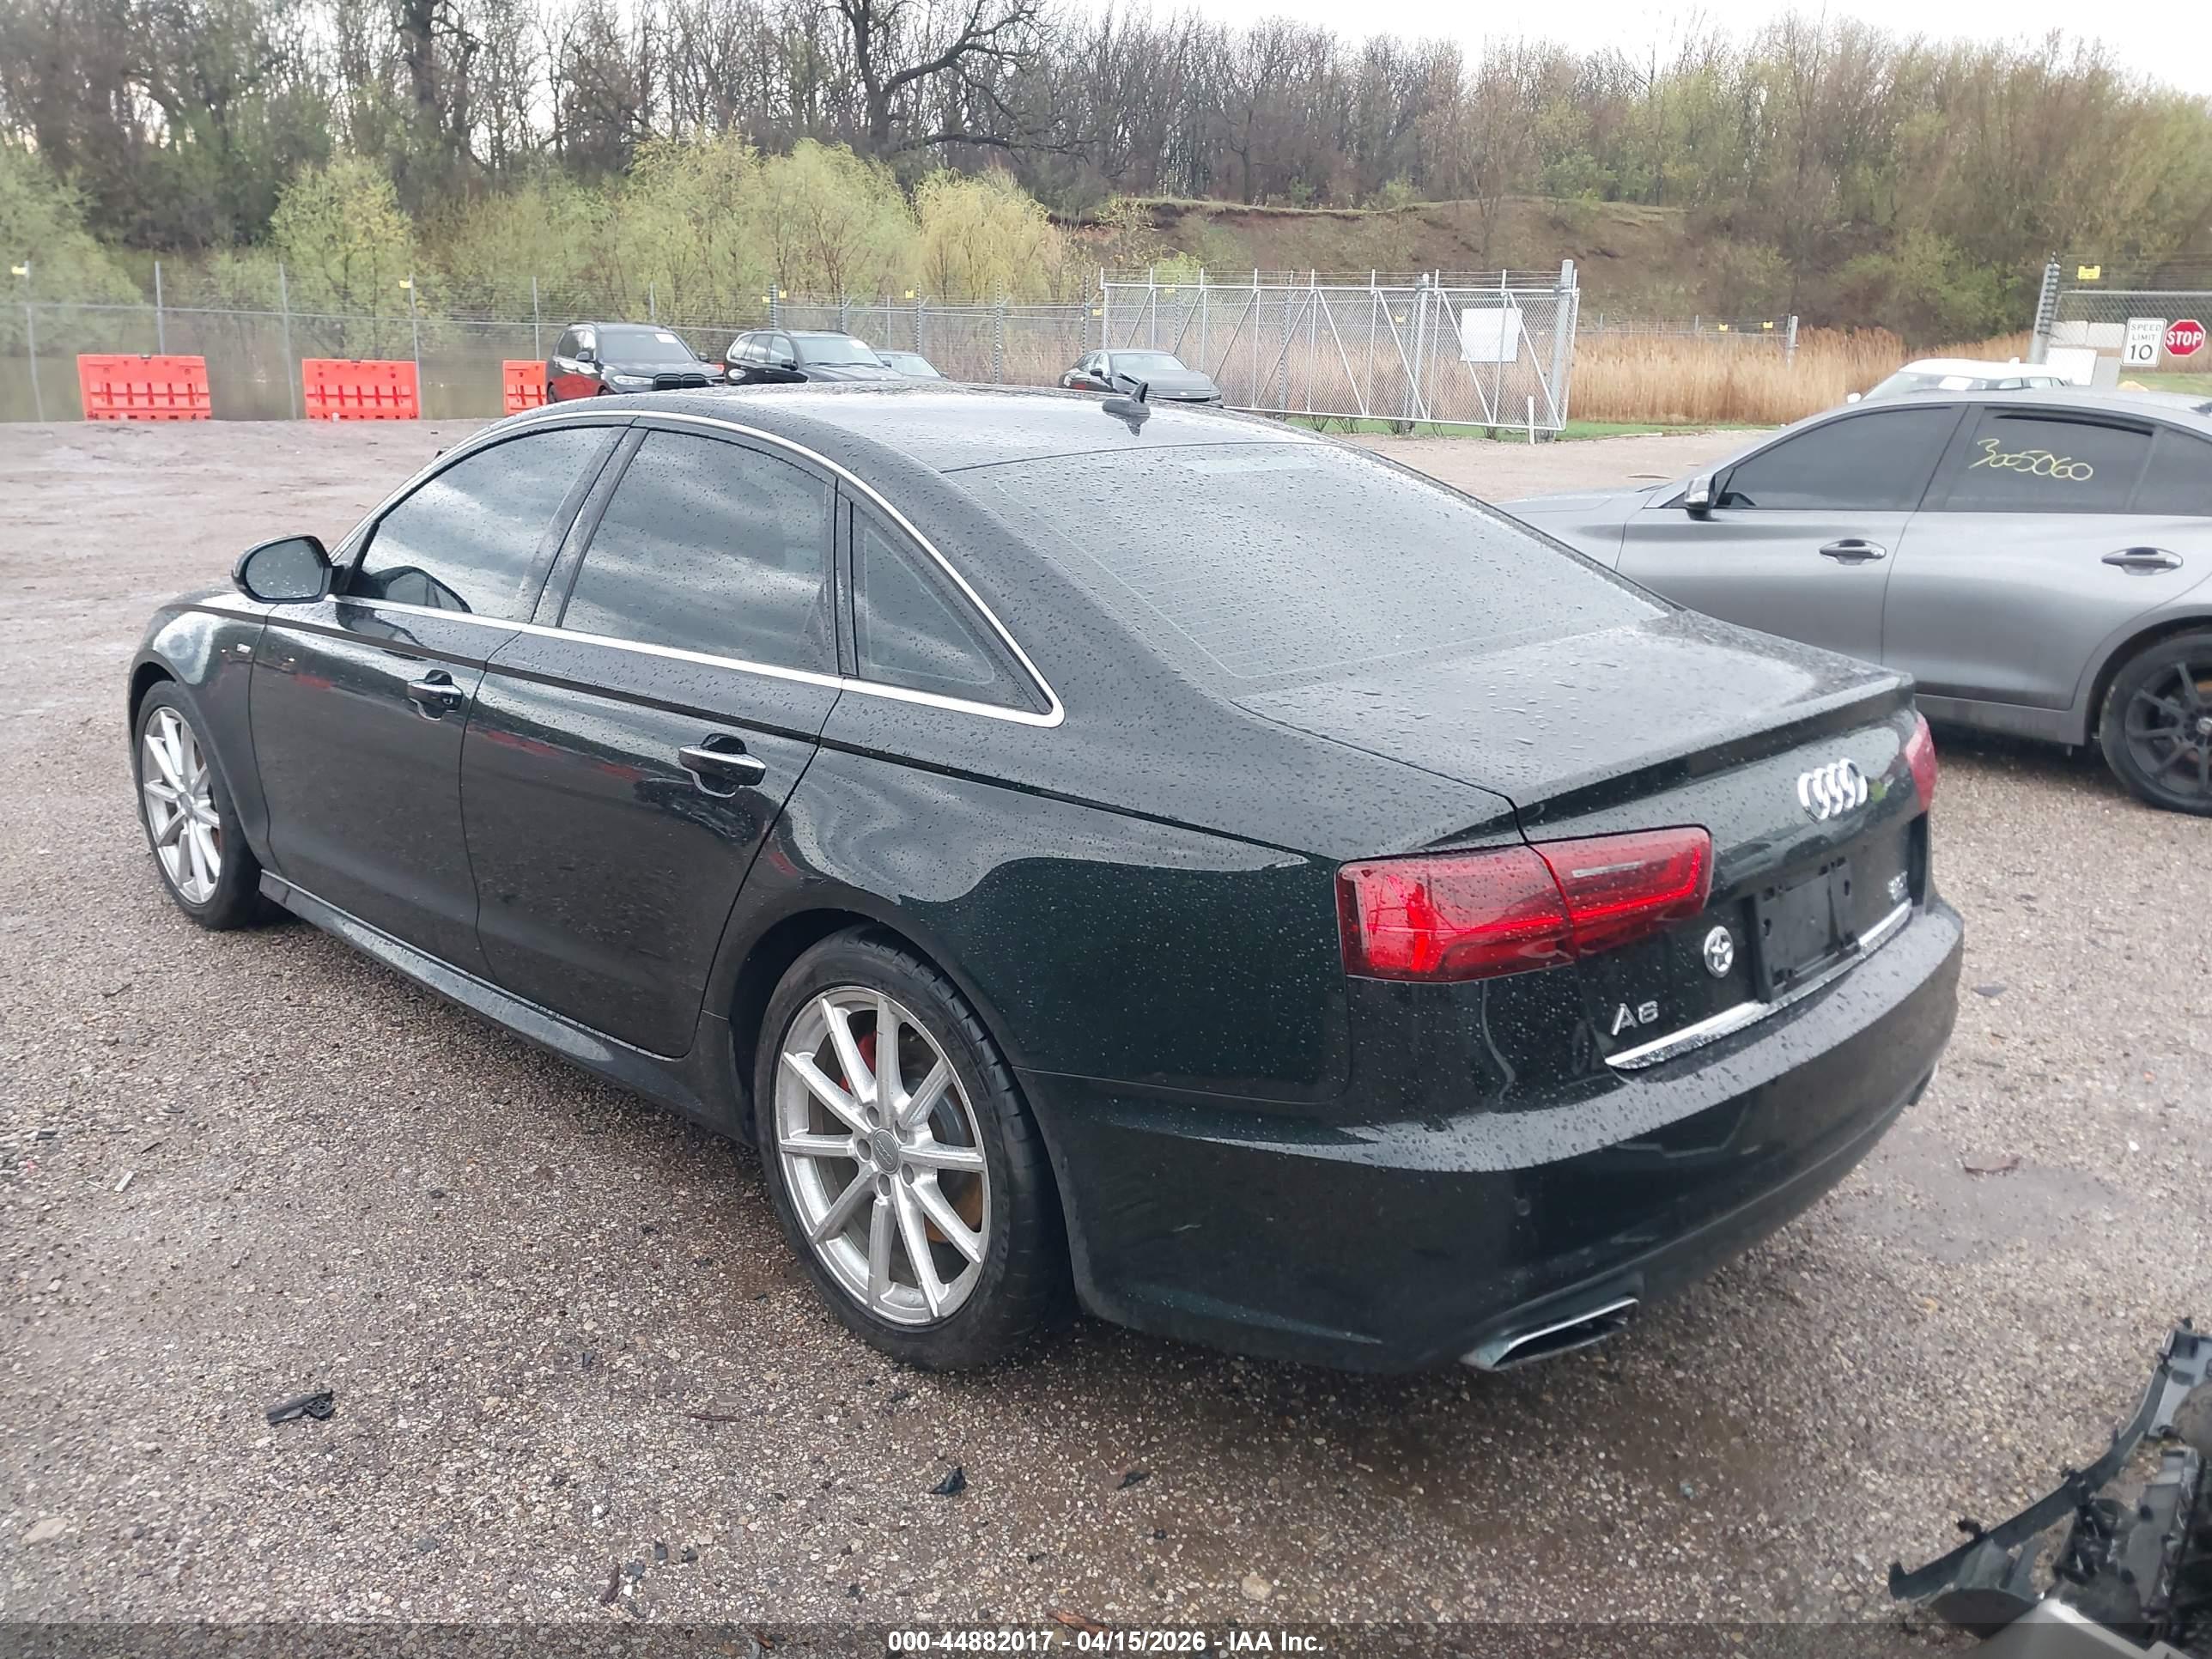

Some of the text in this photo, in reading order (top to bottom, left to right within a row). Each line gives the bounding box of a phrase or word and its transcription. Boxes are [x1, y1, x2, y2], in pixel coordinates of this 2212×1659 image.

[2130, 323, 2161, 331] SPEED
[2166, 331, 2203, 347] STOP
[2130, 344, 2153, 360] 10
[1968, 438, 2094, 481] 3005060
[1612, 1000, 1659, 1036] A6
